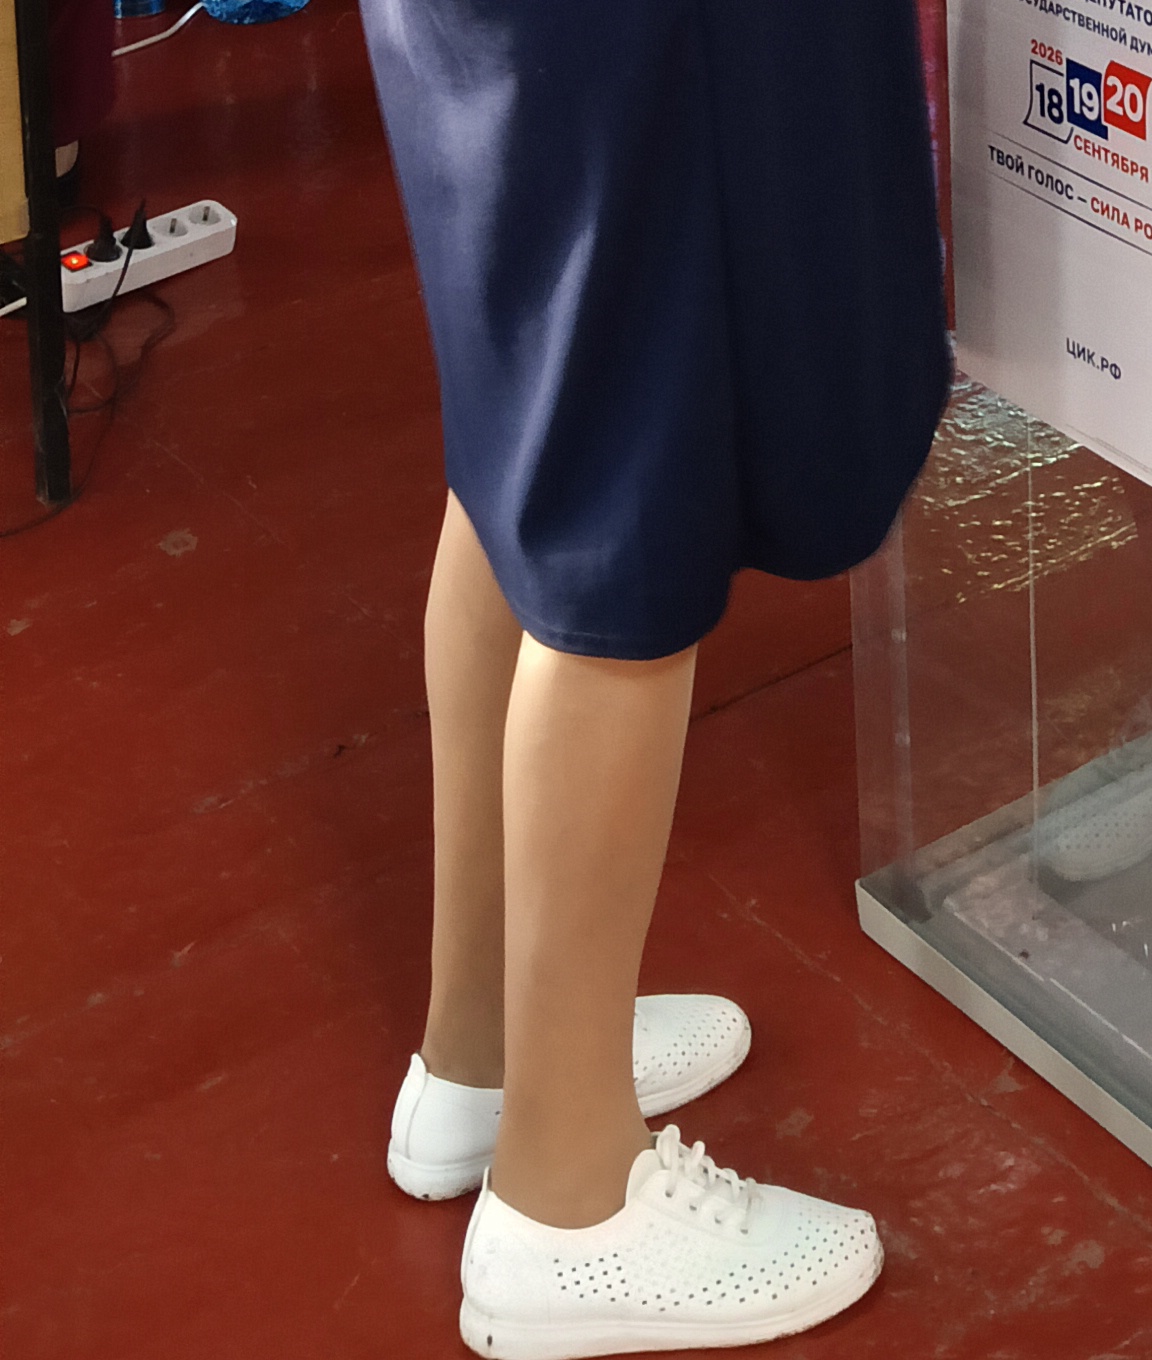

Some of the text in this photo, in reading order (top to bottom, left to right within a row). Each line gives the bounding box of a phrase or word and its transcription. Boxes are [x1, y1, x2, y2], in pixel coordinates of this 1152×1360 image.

[1030, 38, 1063, 66] 2026
[1035, 75, 1144, 125] 18 19 20
[1073, 134, 1149, 183] СЕНТЯБРЯ
[988, 144, 1025, 176] ТВОЙ
[1028, 166, 1074, 200] ГОЛОС
[1091, 196, 1131, 229] СИЛА
[1066, 337, 1122, 380] ЦИК.РФ
